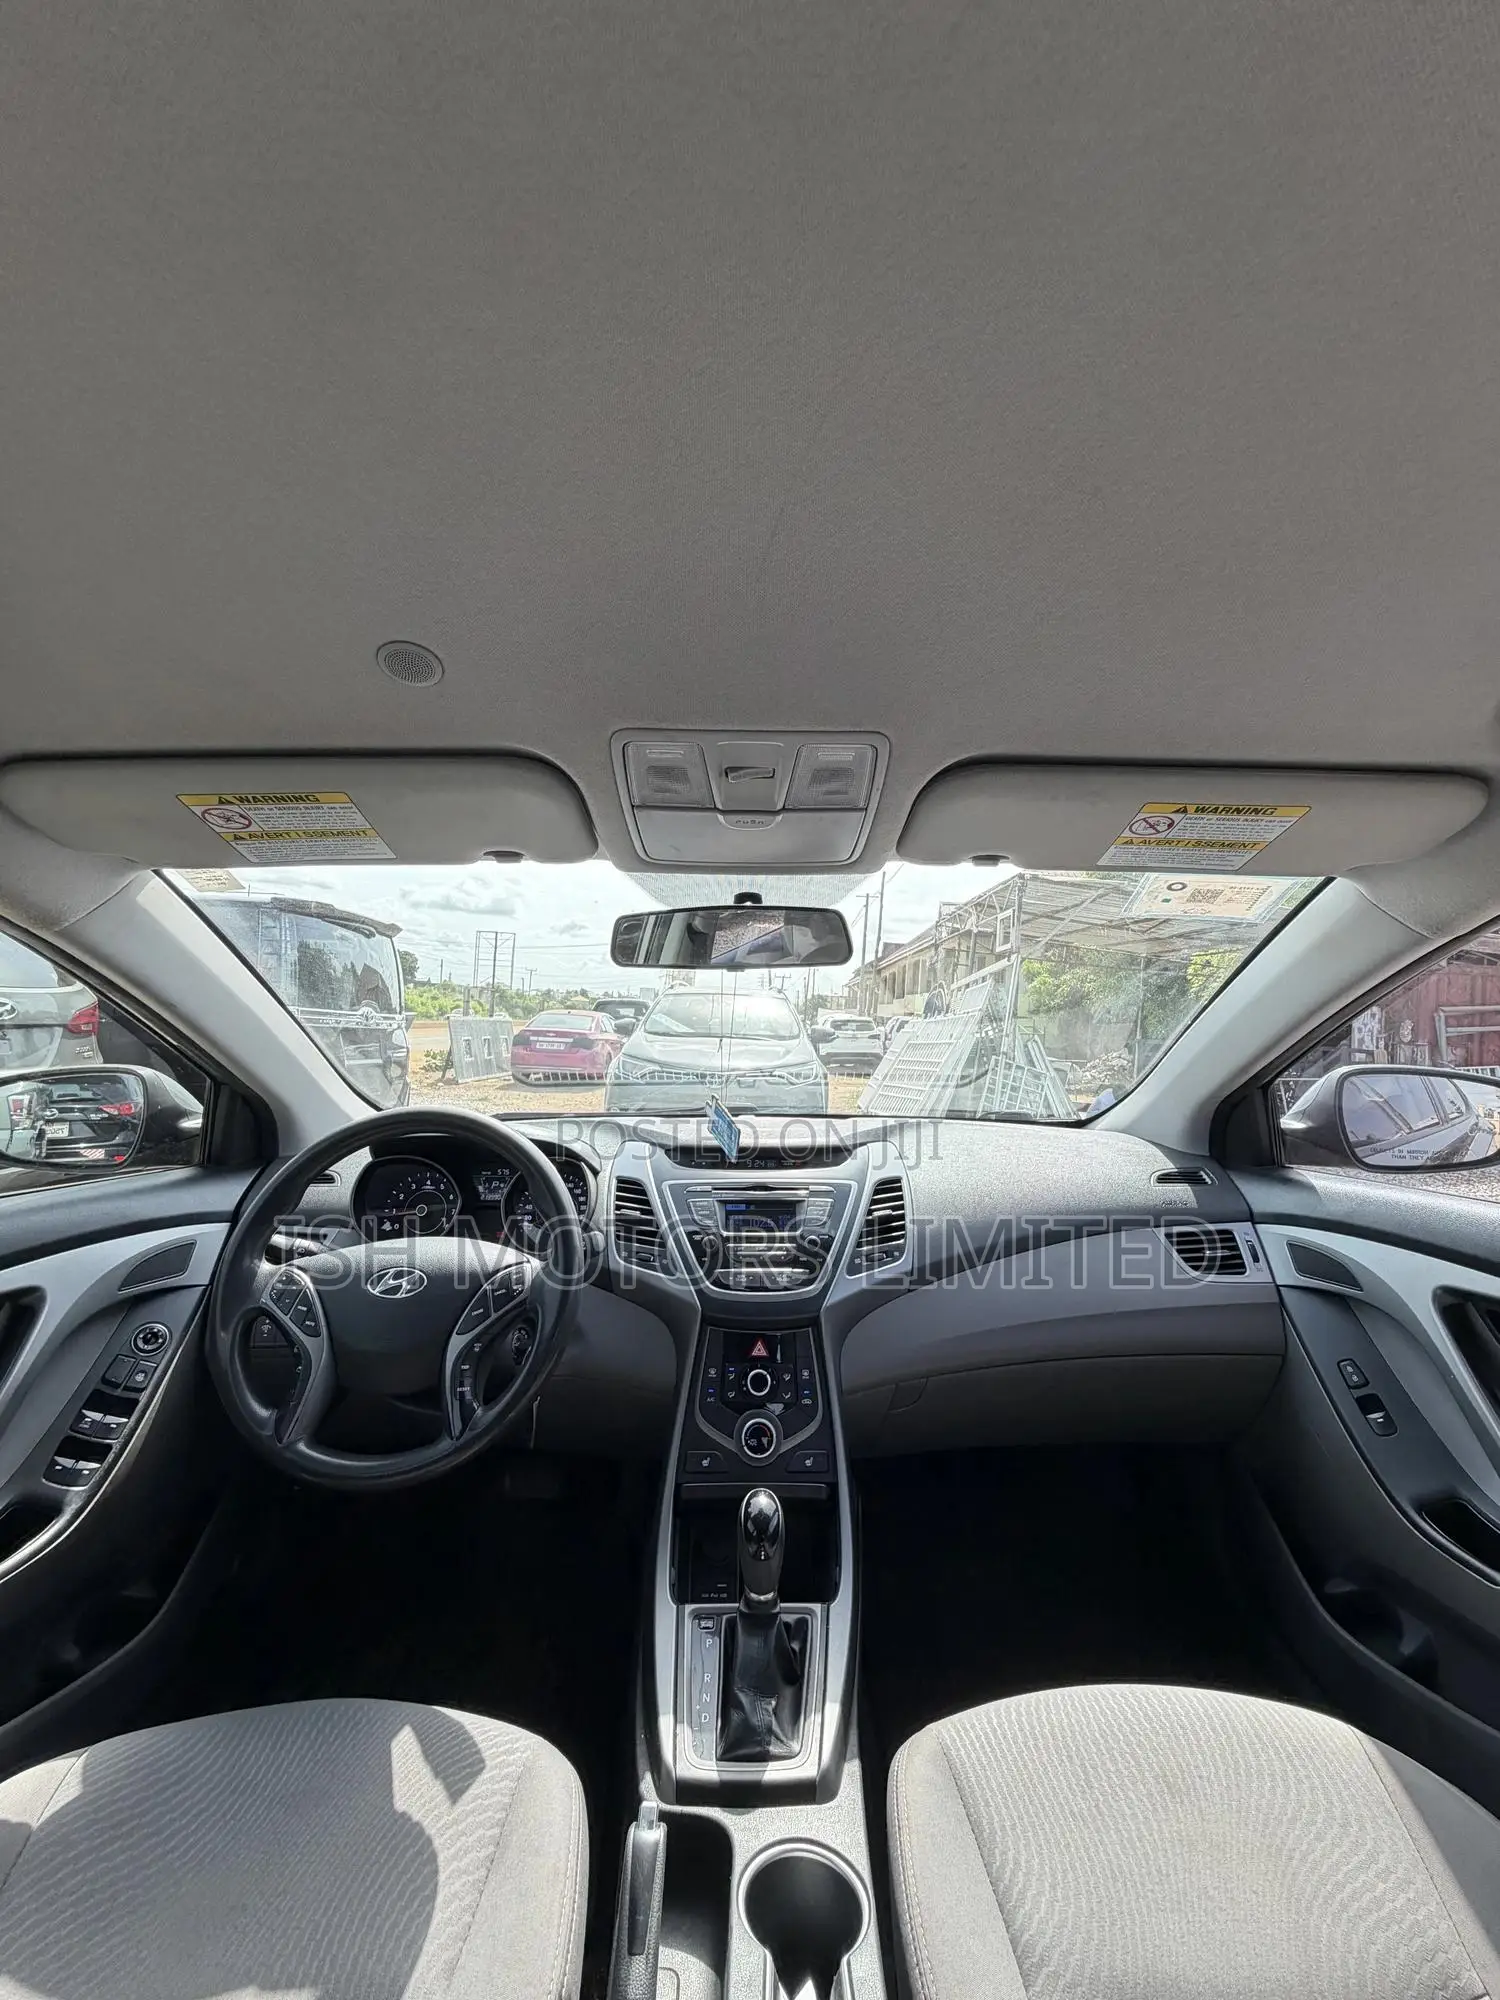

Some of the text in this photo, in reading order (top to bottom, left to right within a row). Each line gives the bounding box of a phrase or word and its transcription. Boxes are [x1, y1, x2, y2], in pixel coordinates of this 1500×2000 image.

[232, 794, 321, 804] WARNING
[1193, 805, 1278, 816] WARNING
[706, 1638, 713, 1648] P
[704, 1673, 712, 1683] R
[702, 1692, 711, 1703] N
[702, 1712, 710, 1723] D
